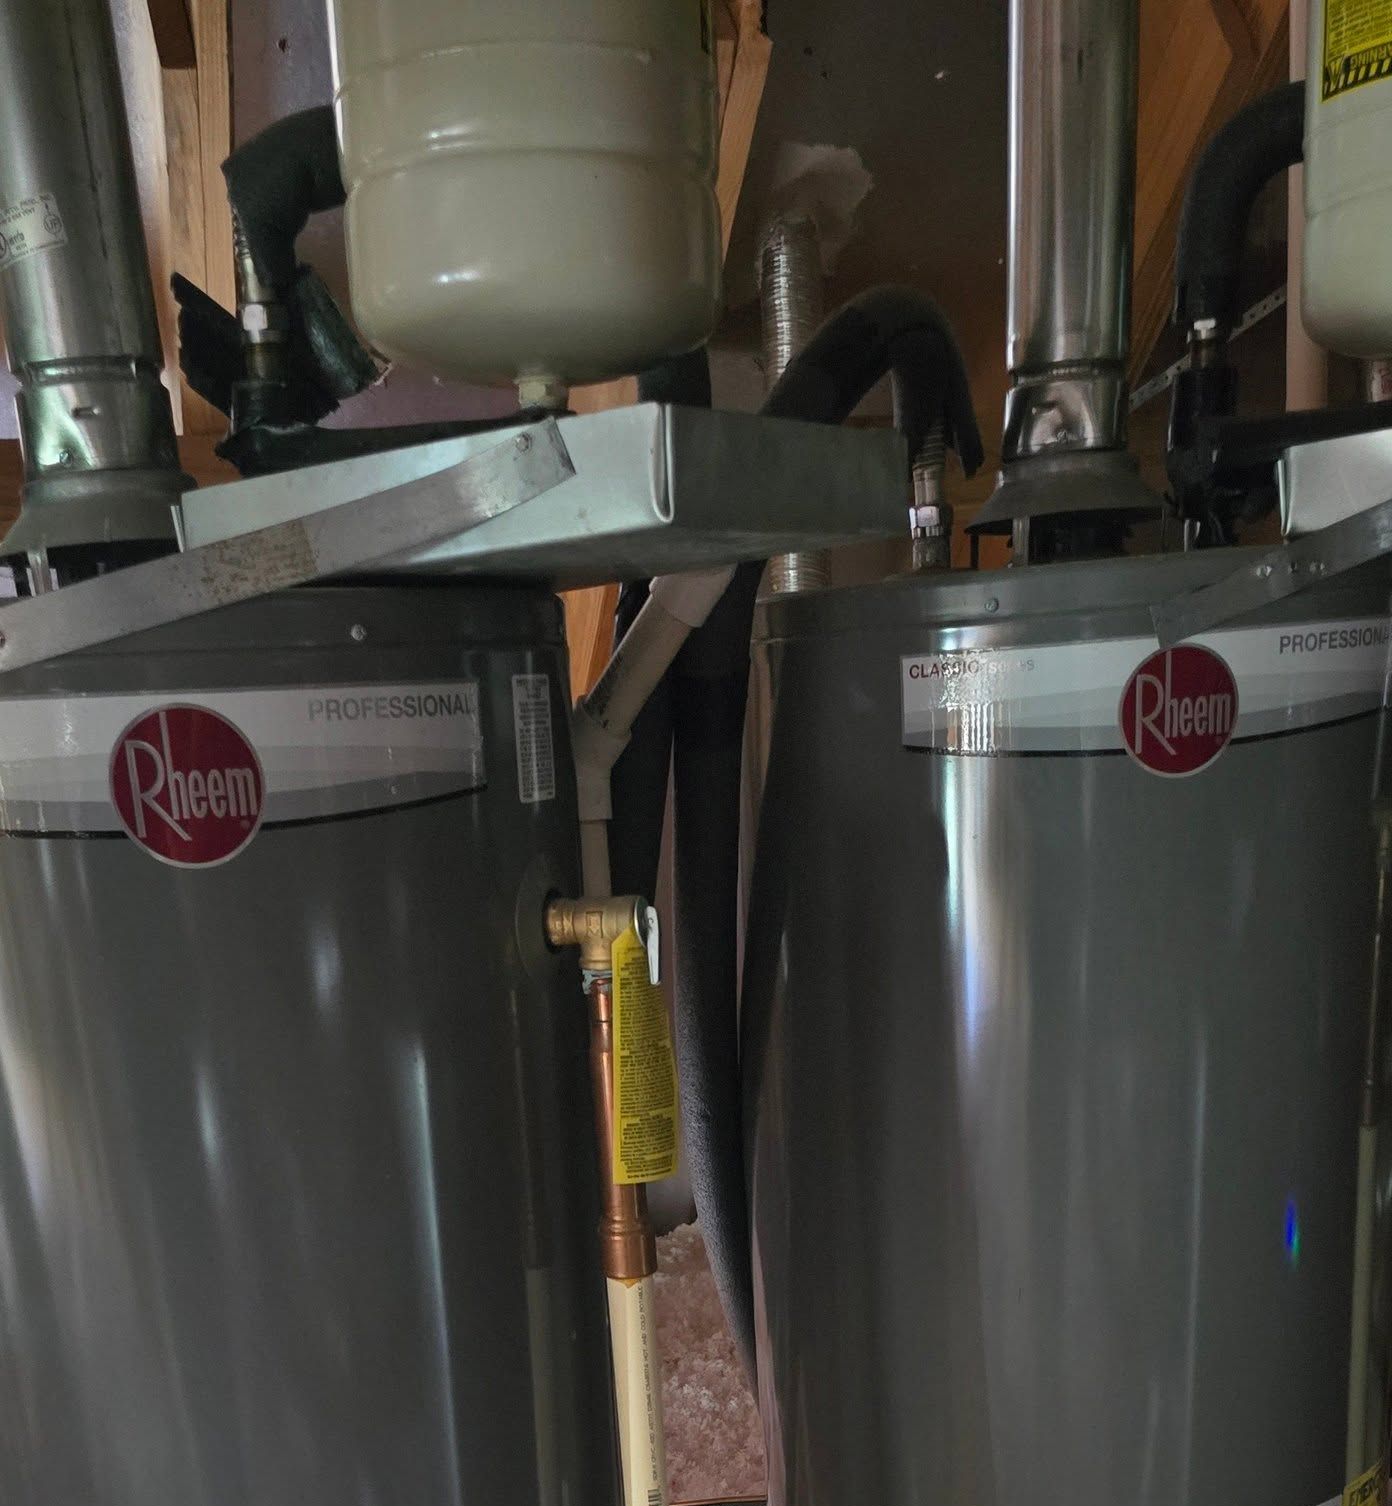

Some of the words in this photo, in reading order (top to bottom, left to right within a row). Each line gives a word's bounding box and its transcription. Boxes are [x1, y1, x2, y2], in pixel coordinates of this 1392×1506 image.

[308, 693, 473, 722] PROFESSIONAL
[1134, 650, 1232, 756] Rheem
[122, 709, 258, 841] Rheem
